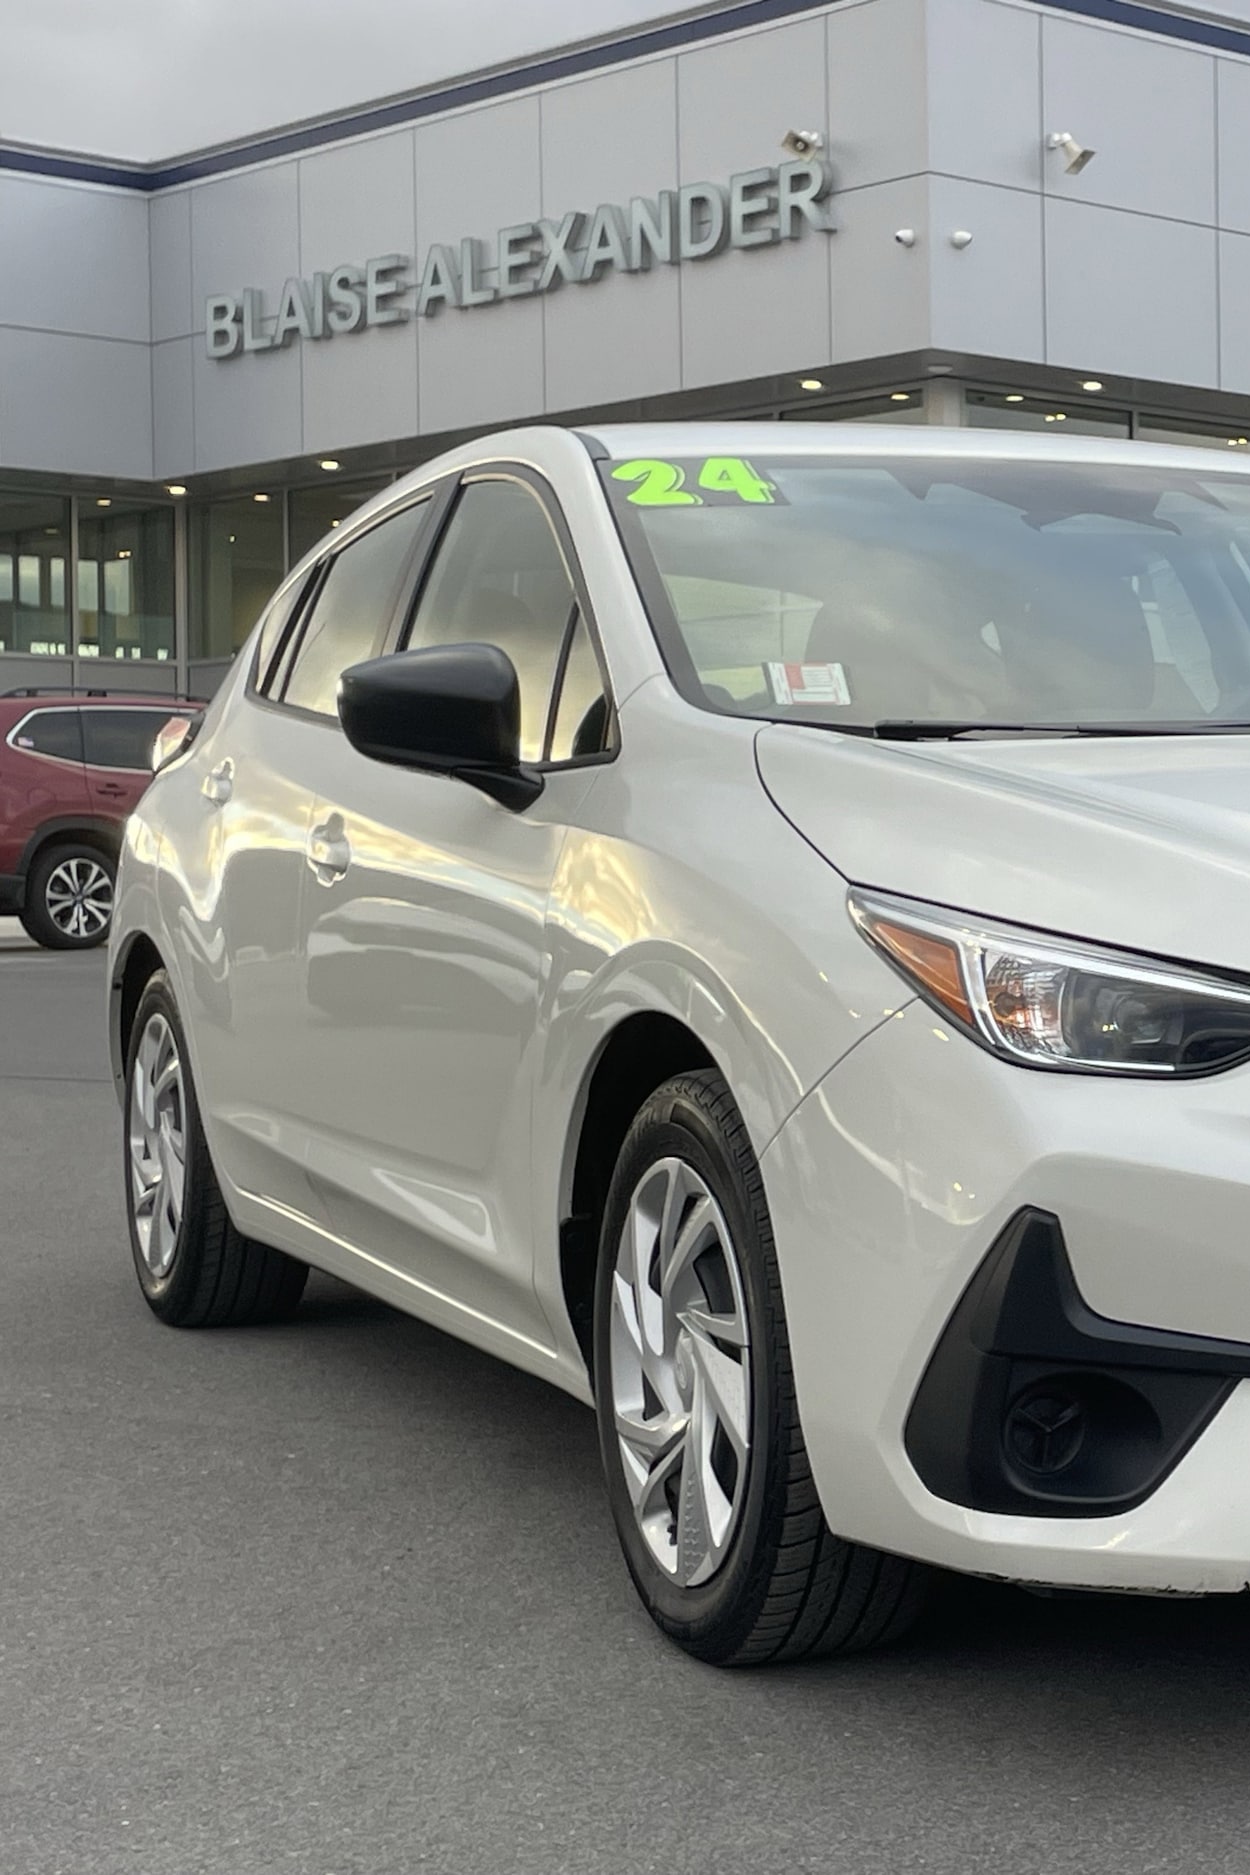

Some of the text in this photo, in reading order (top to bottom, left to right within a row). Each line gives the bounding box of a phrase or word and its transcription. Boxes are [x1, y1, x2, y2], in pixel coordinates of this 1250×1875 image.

[205, 160, 837, 360] BLAISE ALEXANDER
[611, 457, 776, 506] 24
